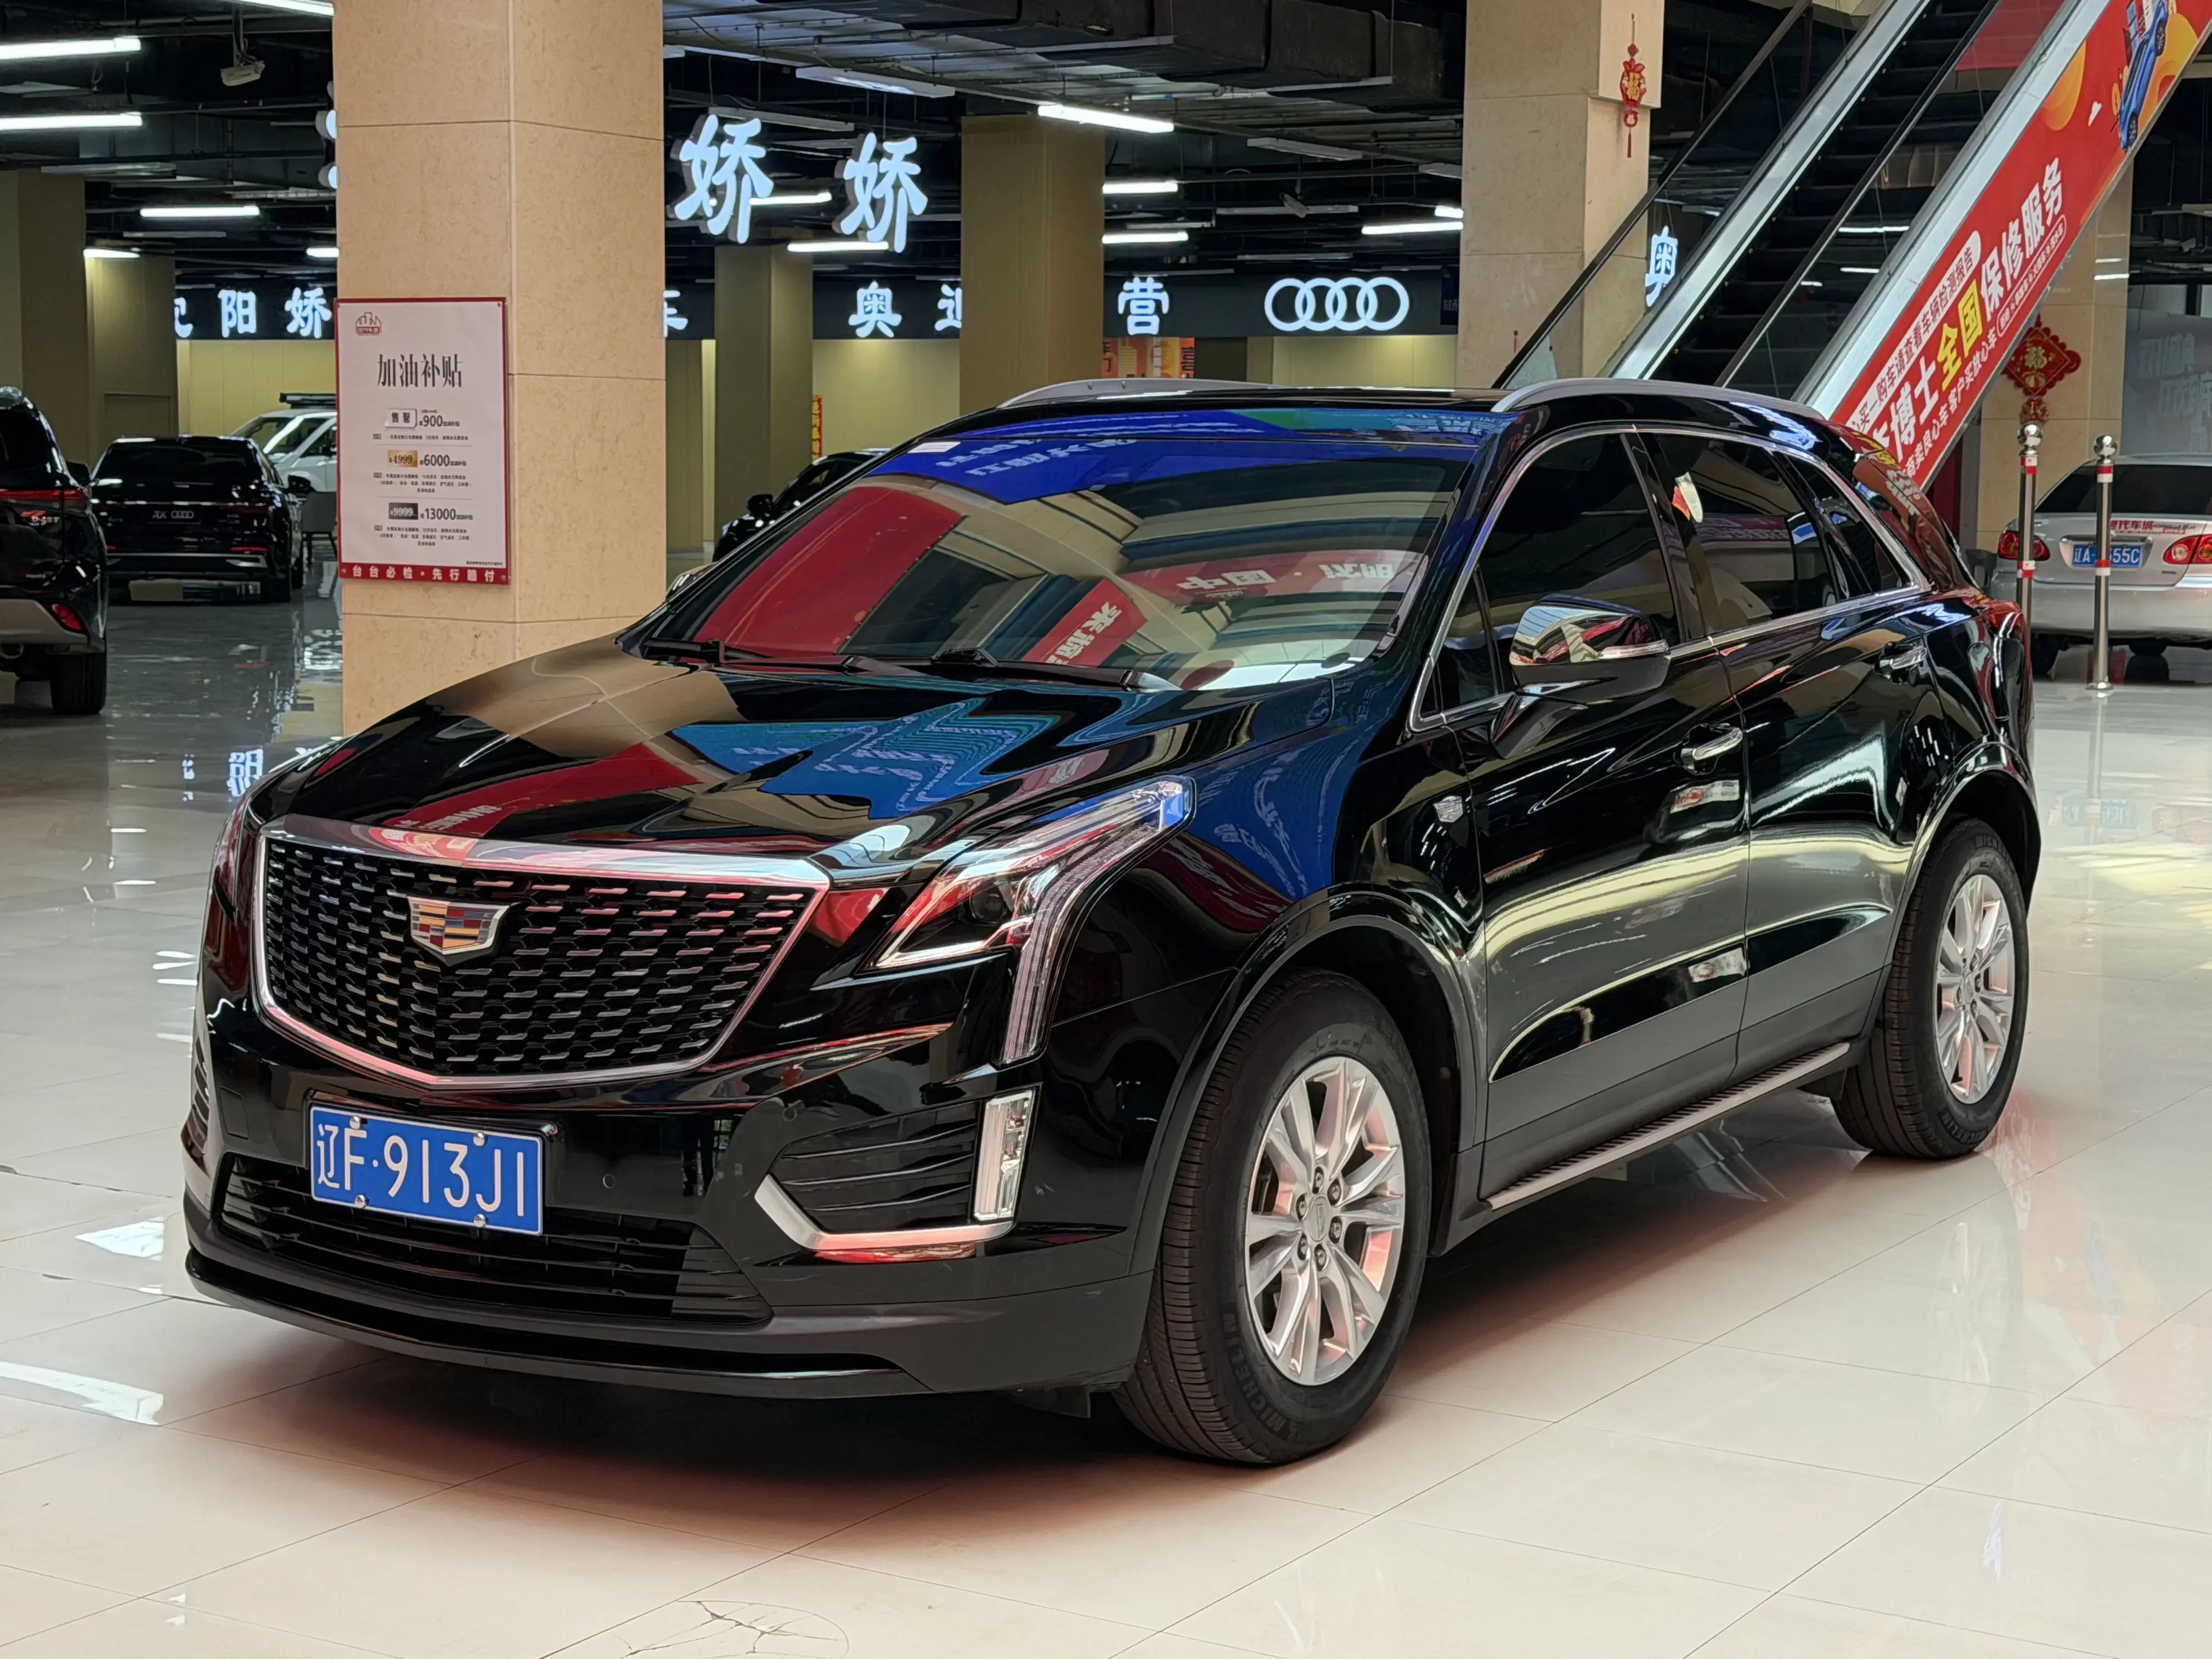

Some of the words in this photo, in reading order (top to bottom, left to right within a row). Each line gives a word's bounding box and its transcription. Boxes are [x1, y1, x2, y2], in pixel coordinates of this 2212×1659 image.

[674, 114, 928, 253] 娇娇
[1118, 276, 1170, 336] 营
[377, 353, 463, 388] 加油补贴
[2073, 547, 2140, 564] 辽A·55C
[317, 1123, 524, 1217] 辽F·913J1
